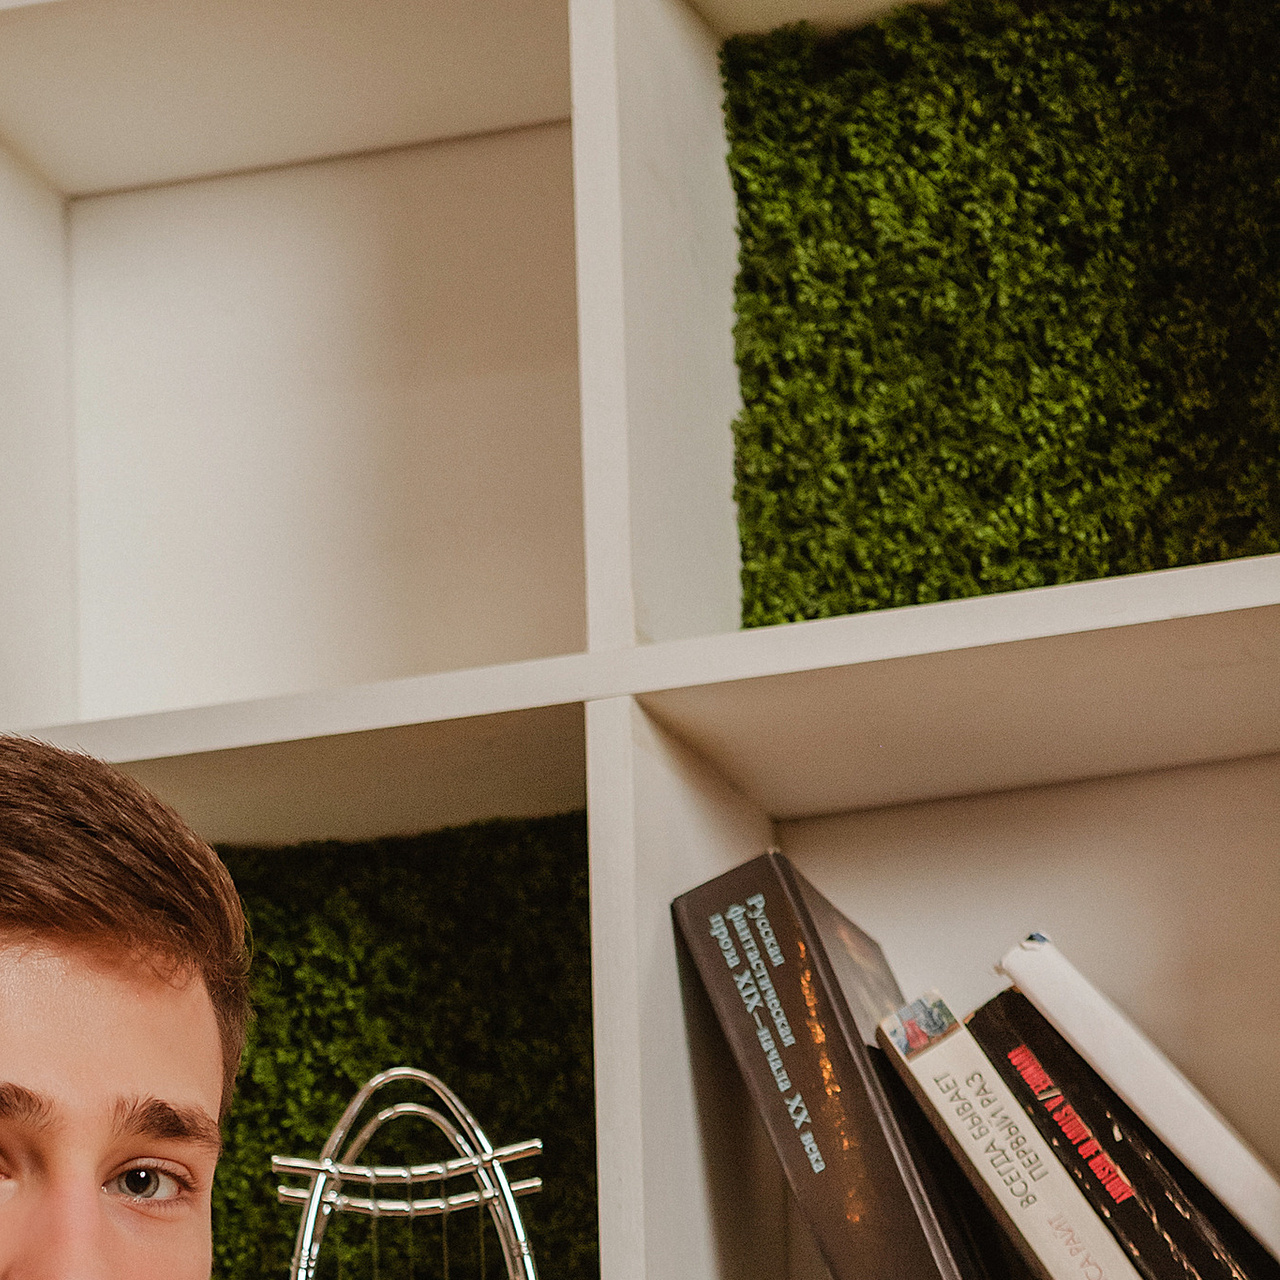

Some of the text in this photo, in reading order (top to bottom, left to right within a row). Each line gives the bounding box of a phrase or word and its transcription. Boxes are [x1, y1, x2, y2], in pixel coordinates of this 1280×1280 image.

[745, 893, 785, 967] Русская
[725, 904, 796, 1047] фантастическая
[709, 913, 740, 969] проза
[800, 1131, 826, 1174] века
[933, 1073, 1037, 1209] ВСЕГДА БЫВАЕТ
[966, 1072, 1049, 1182] ПЕРВЫЙ РАЗ
[1052, 1104, 1093, 1146] STUDY
[1078, 1138, 1102, 1160] OF
[1088, 1152, 1136, 1205] HISTORY
[1048, 1213, 1086, 1257] РАЙТ
